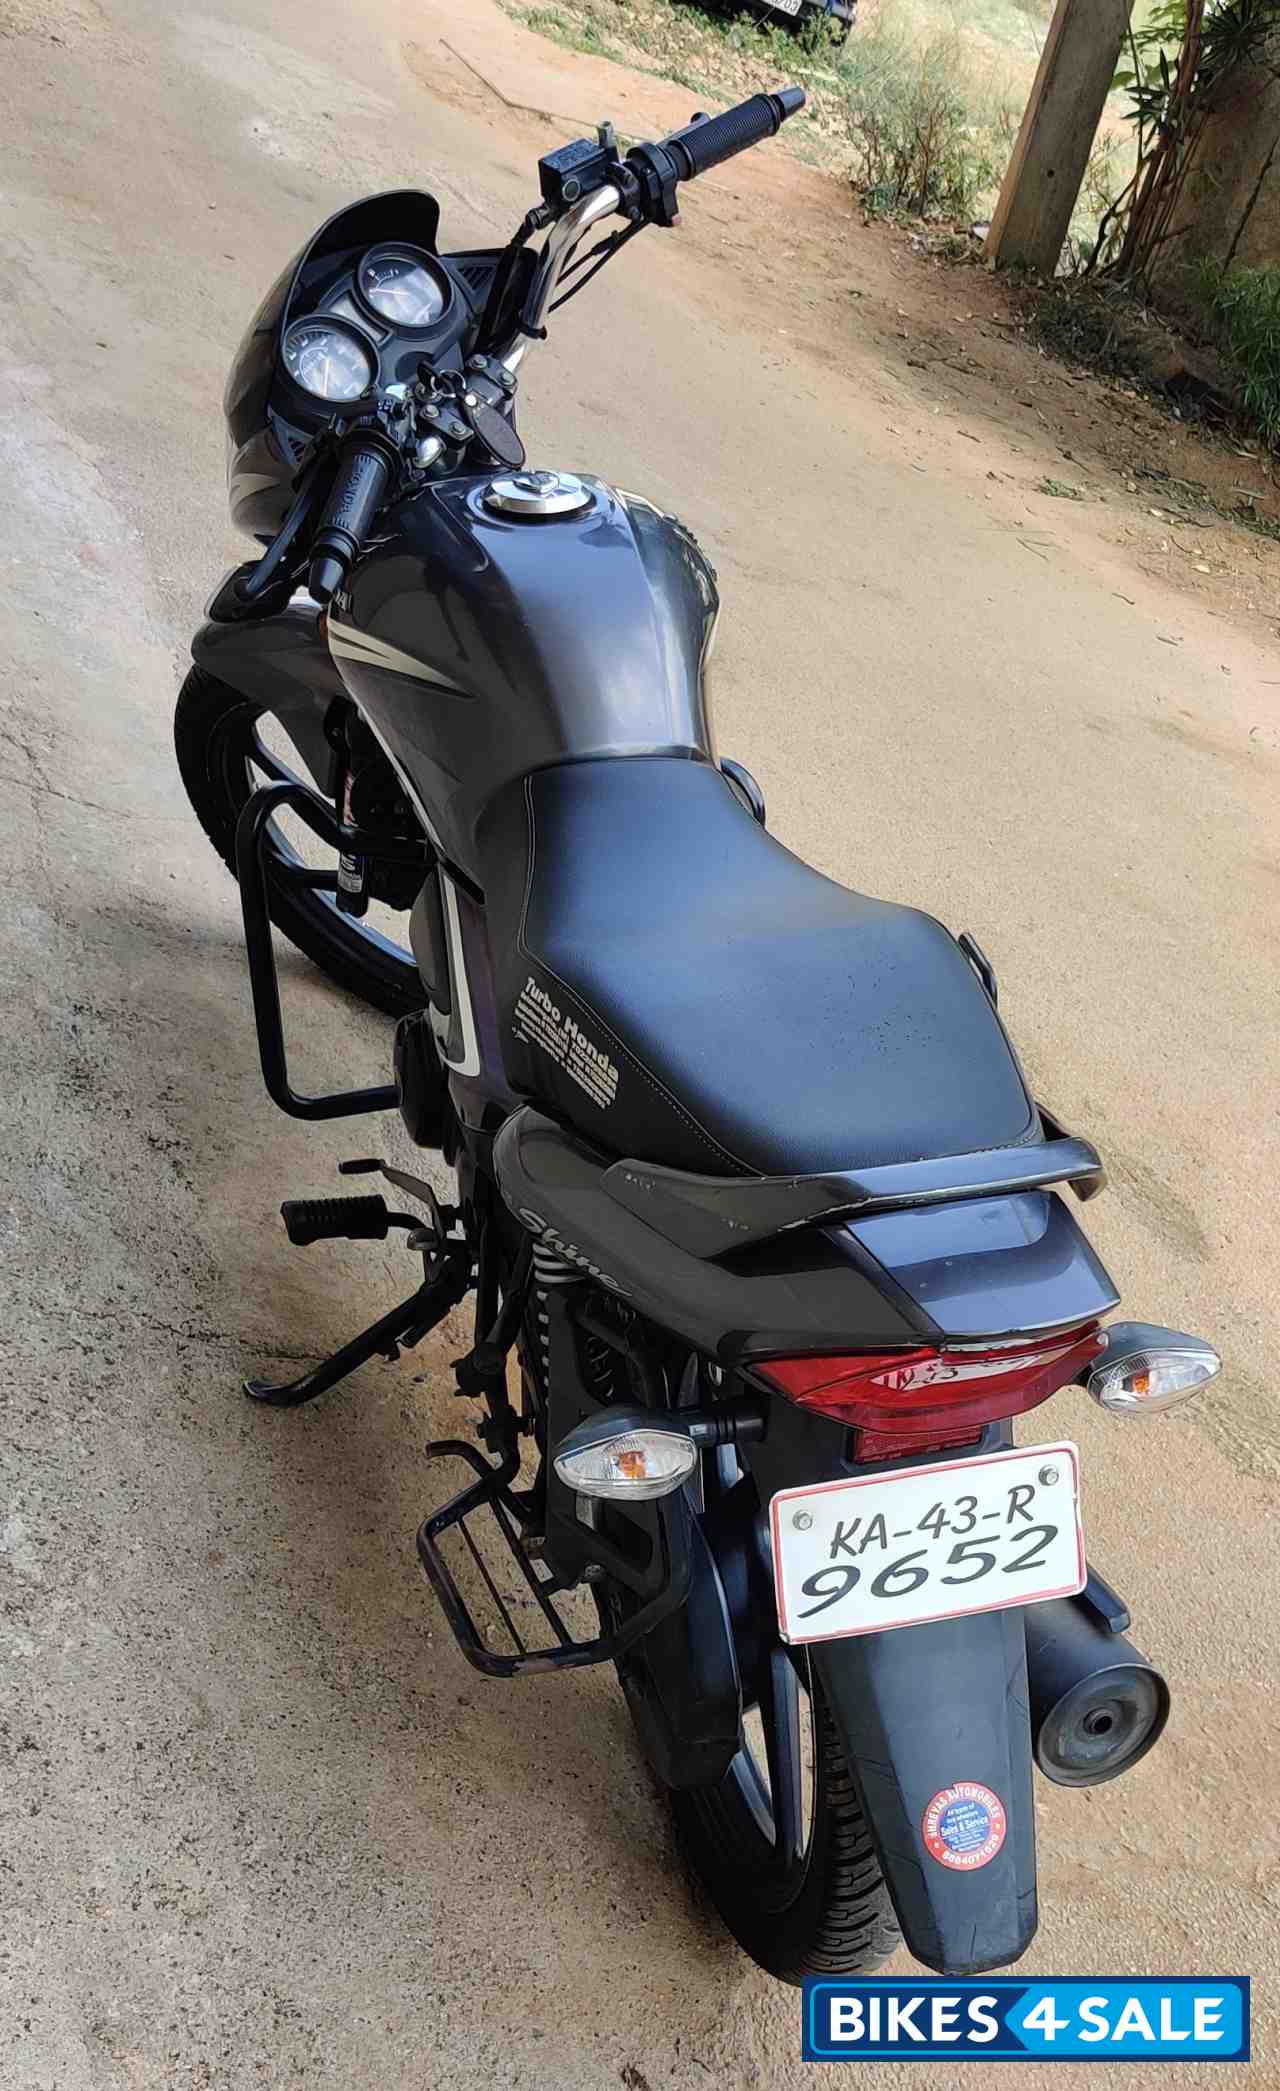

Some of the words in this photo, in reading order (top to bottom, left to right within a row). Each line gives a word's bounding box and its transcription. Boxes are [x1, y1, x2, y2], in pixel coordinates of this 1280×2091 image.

[525, 976, 561, 1022] Turbo
[564, 1016, 619, 1083] Honda
[829, 1484, 1035, 1559] KA-43-R
[797, 1524, 1058, 1619] 9652
